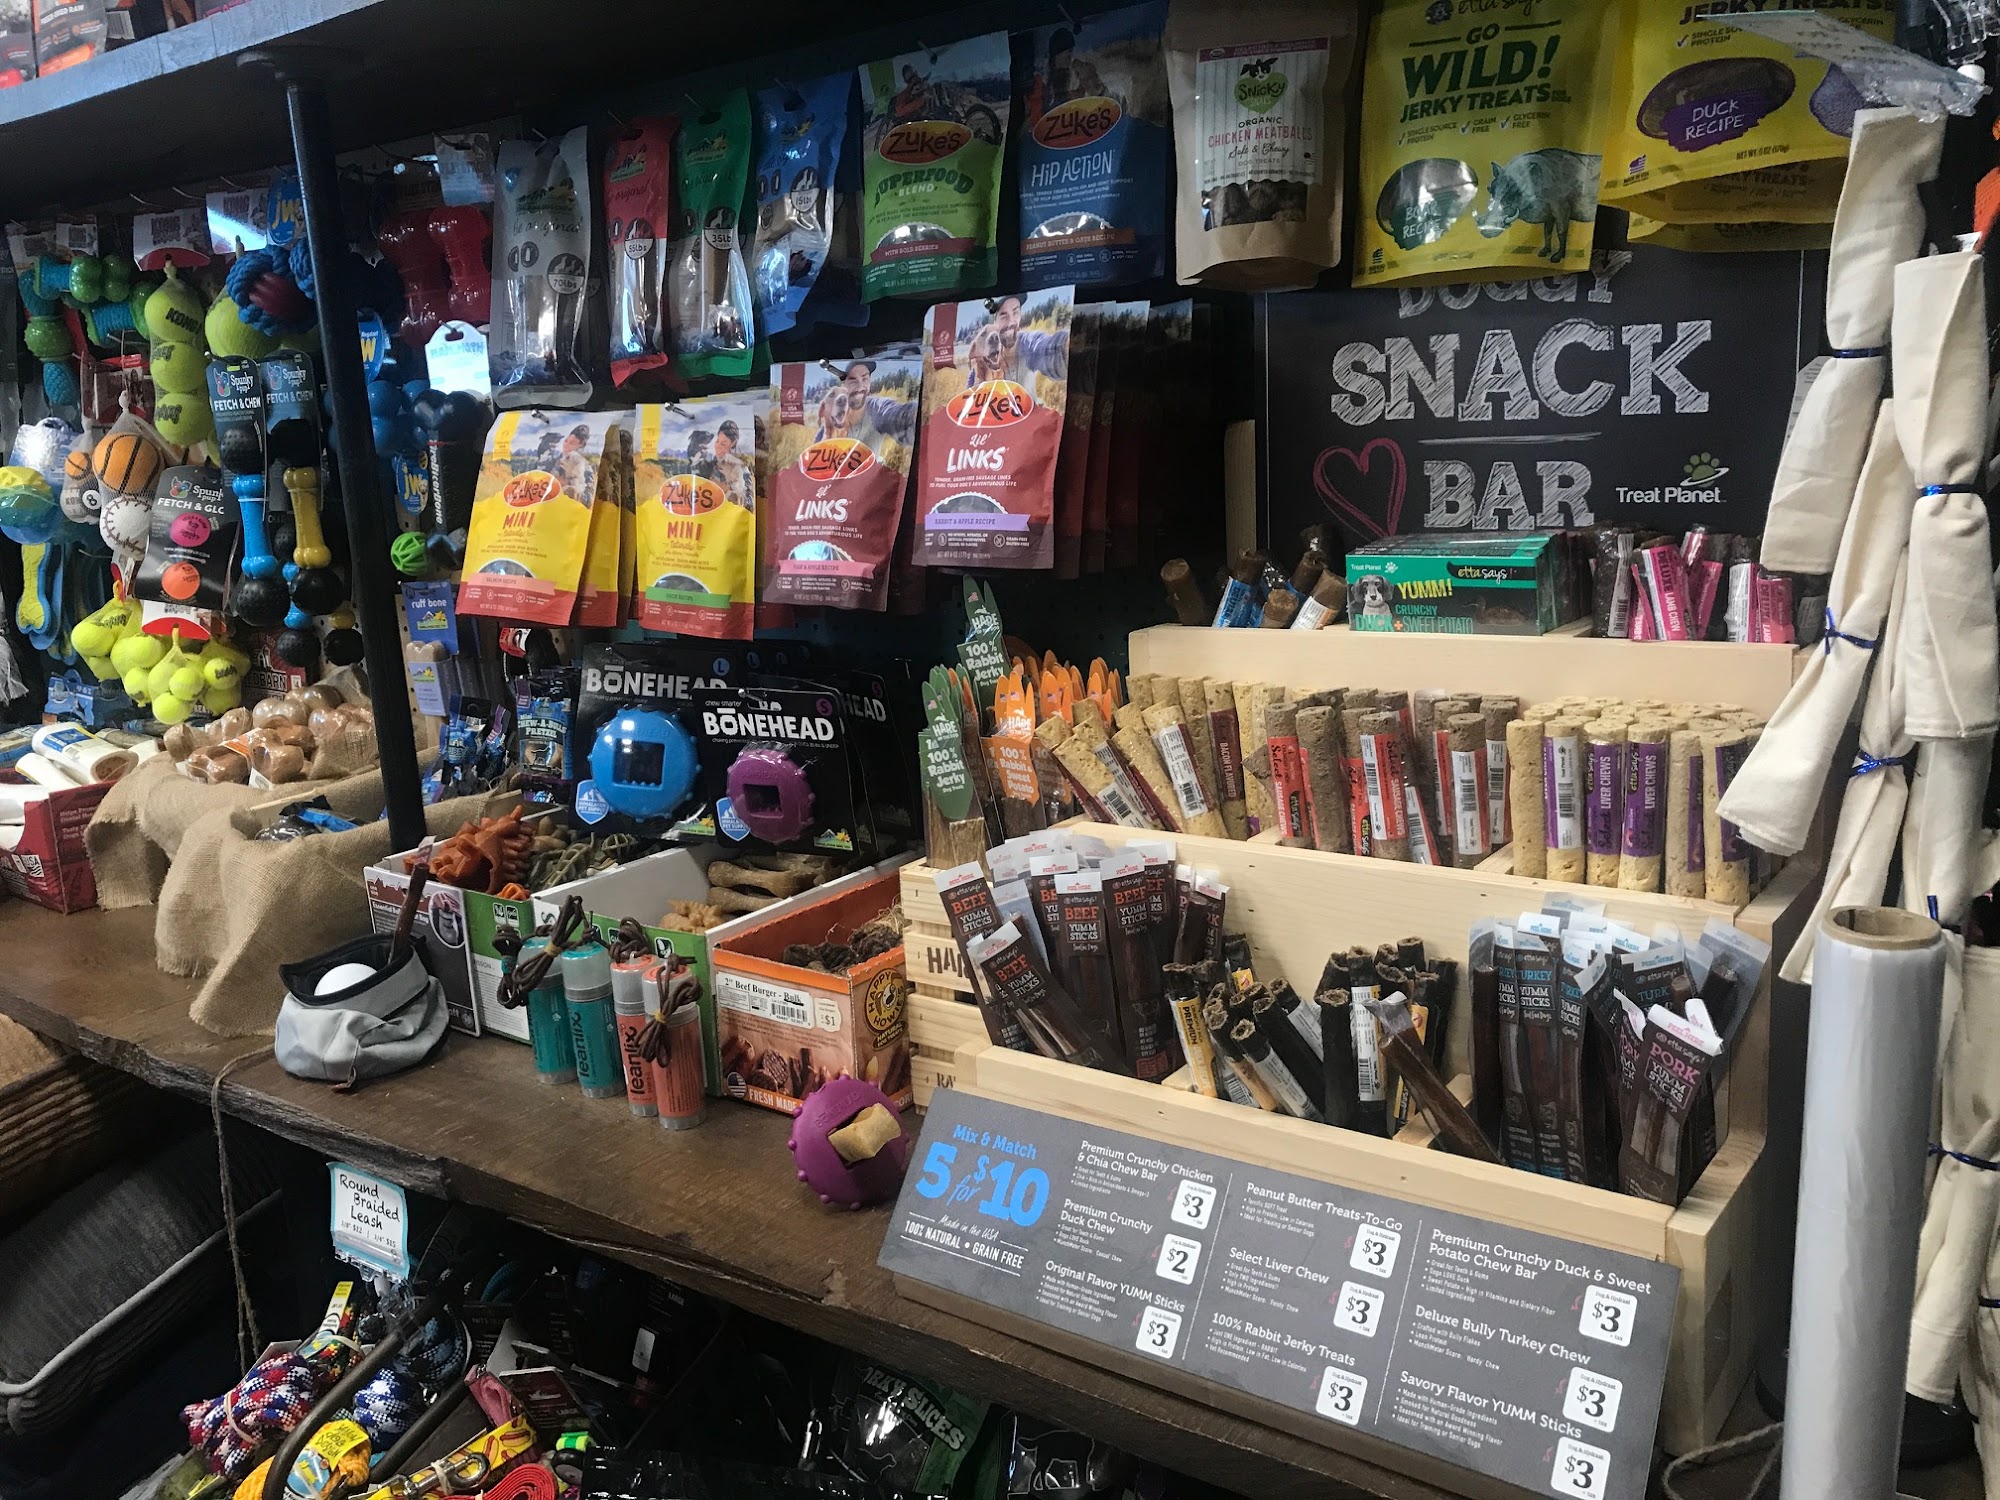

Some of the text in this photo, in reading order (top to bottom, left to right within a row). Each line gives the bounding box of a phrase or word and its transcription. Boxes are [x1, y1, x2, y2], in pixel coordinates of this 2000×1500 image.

[1466, 23, 1500, 45] GO
[1691, 35, 1731, 47] PROTEIN
[1402, 35, 1561, 98] WILD!
[1400, 83, 1551, 123] JERKY TREATS
[1692, 100, 1740, 123] DUCK
[1238, 116, 1283, 129] ORGANIC
[1685, 114, 1745, 140] RECIPE
[1208, 126, 1313, 148] CHICKEN MEATBALLS
[874, 167, 974, 208] SUPERFOOD
[898, 183, 934, 197] BLEND
[230, 371, 254, 390] Spunky
[1330, 318, 1712, 427] SNACK
[214, 398, 245, 411] FETCH &
[266, 392, 289, 404] FETCH
[947, 446, 1007, 473] LINKS
[157, 498, 202, 511] FETCH &
[1423, 460, 1595, 531] BAR
[1616, 487, 1721, 505] Treat Planet
[503, 511, 536, 527] MINI
[795, 498, 849, 522] LINKS
[667, 521, 703, 540] MINI
[1656, 550, 1674, 594] DELUXE
[1397, 578, 1453, 600] YUMM!
[411, 598, 447, 609] ruff bone
[1395, 604, 1438, 616] CRUNCHY
[1403, 615, 1474, 634] SWEET POTATO
[965, 652, 1004, 671] Rabbit
[974, 667, 1004, 683] Jerky
[525, 726, 558, 739] PRETZEL
[927, 760, 965, 777] Rabbit
[999, 758, 1026, 772] Rabbit
[1006, 769, 1031, 783] Sweet
[936, 772, 965, 788] Jerky
[1006, 779, 1035, 794] Potato
[1600, 756, 1611, 810] LIVER CHEWS
[1645, 755, 1657, 810] LIVER CHEWS
[1277, 781, 1286, 811] SAUSAGE
[1279, 811, 1288, 836] CHEWS
[951, 891, 987, 914] BEEF
[1113, 885, 1147, 905] BEEF
[960, 907, 989, 924] YUMM
[1064, 906, 1099, 920] BEEF
[1120, 903, 1147, 917] YUMM
[1121, 912, 1148, 926] STICKS
[963, 918, 992, 932] STICKS
[1069, 923, 1097, 932] YUMM
[1070, 932, 1098, 941] STICKS
[995, 954, 1028, 982] BEEF
[1008, 970, 1034, 990] YUMM
[735, 979, 777, 998] Beef Burger
[1013, 977, 1040, 997] STICKS
[1520, 986, 1549, 997] YUMM
[1520, 996, 1551, 1007] STICKS
[1649, 1042, 1701, 1085] PORK
[1649, 1070, 1684, 1103] STICKS
[1652, 1061, 1687, 1094] YUMM
[750, 1087, 774, 1106] FRESH
[953, 1124, 1037, 1160] Mix & Match
[1081, 1140, 1214, 1183] Premium Crunchy Chicken
[1086, 1154, 1109, 1169] Chia
[1111, 1160, 1140, 1176] Chew
[1141, 1168, 1158, 1182] Bar
[339, 1174, 380, 1199] Round
[915, 1141, 1050, 1227] 5 $10
[351, 1205, 383, 1230] Leash
[353, 1192, 400, 1222] Braided
[1063, 1198, 1154, 1234] Premium Crunchy
[1182, 1193, 1204, 1219] $3
[1246, 1182, 1403, 1231] Peanut Butter Treats-To-Go
[981, 1227, 999, 1242] USA
[1060, 1210, 1116, 1235] Duck Chew
[904, 1219, 1024, 1269] 100% NATURAL GRAIN FREE
[1362, 1238, 1387, 1266] $3
[1166, 1247, 1189, 1275] $2
[1229, 1247, 1330, 1285] Select Liver Chew
[1429, 1242, 1538, 1281] Potato Chew Bar
[1432, 1229, 1652, 1294] Premium Crunchy Duck Sweet
[1045, 1260, 1085, 1282] Original
[1087, 1272, 1118, 1291] Flavor
[1120, 1283, 1153, 1303] YUMM
[1154, 1294, 1186, 1313] Sticks
[1345, 1296, 1371, 1325] $3
[1592, 1301, 1622, 1333] $3
[1147, 1320, 1169, 1347] $3
[1212, 1312, 1356, 1366] 100% Rabbit Jerky Treats
[1415, 1304, 1592, 1365] Deluxe Bully Turkey Chew
[1328, 1382, 1354, 1412] $3
[1400, 1370, 1583, 1439] Savory Flavor YUMM Sticks
[1576, 1384, 1607, 1418] $3
[903, 1387, 966, 1450] SLICES
[1564, 1454, 1595, 1490] $3
